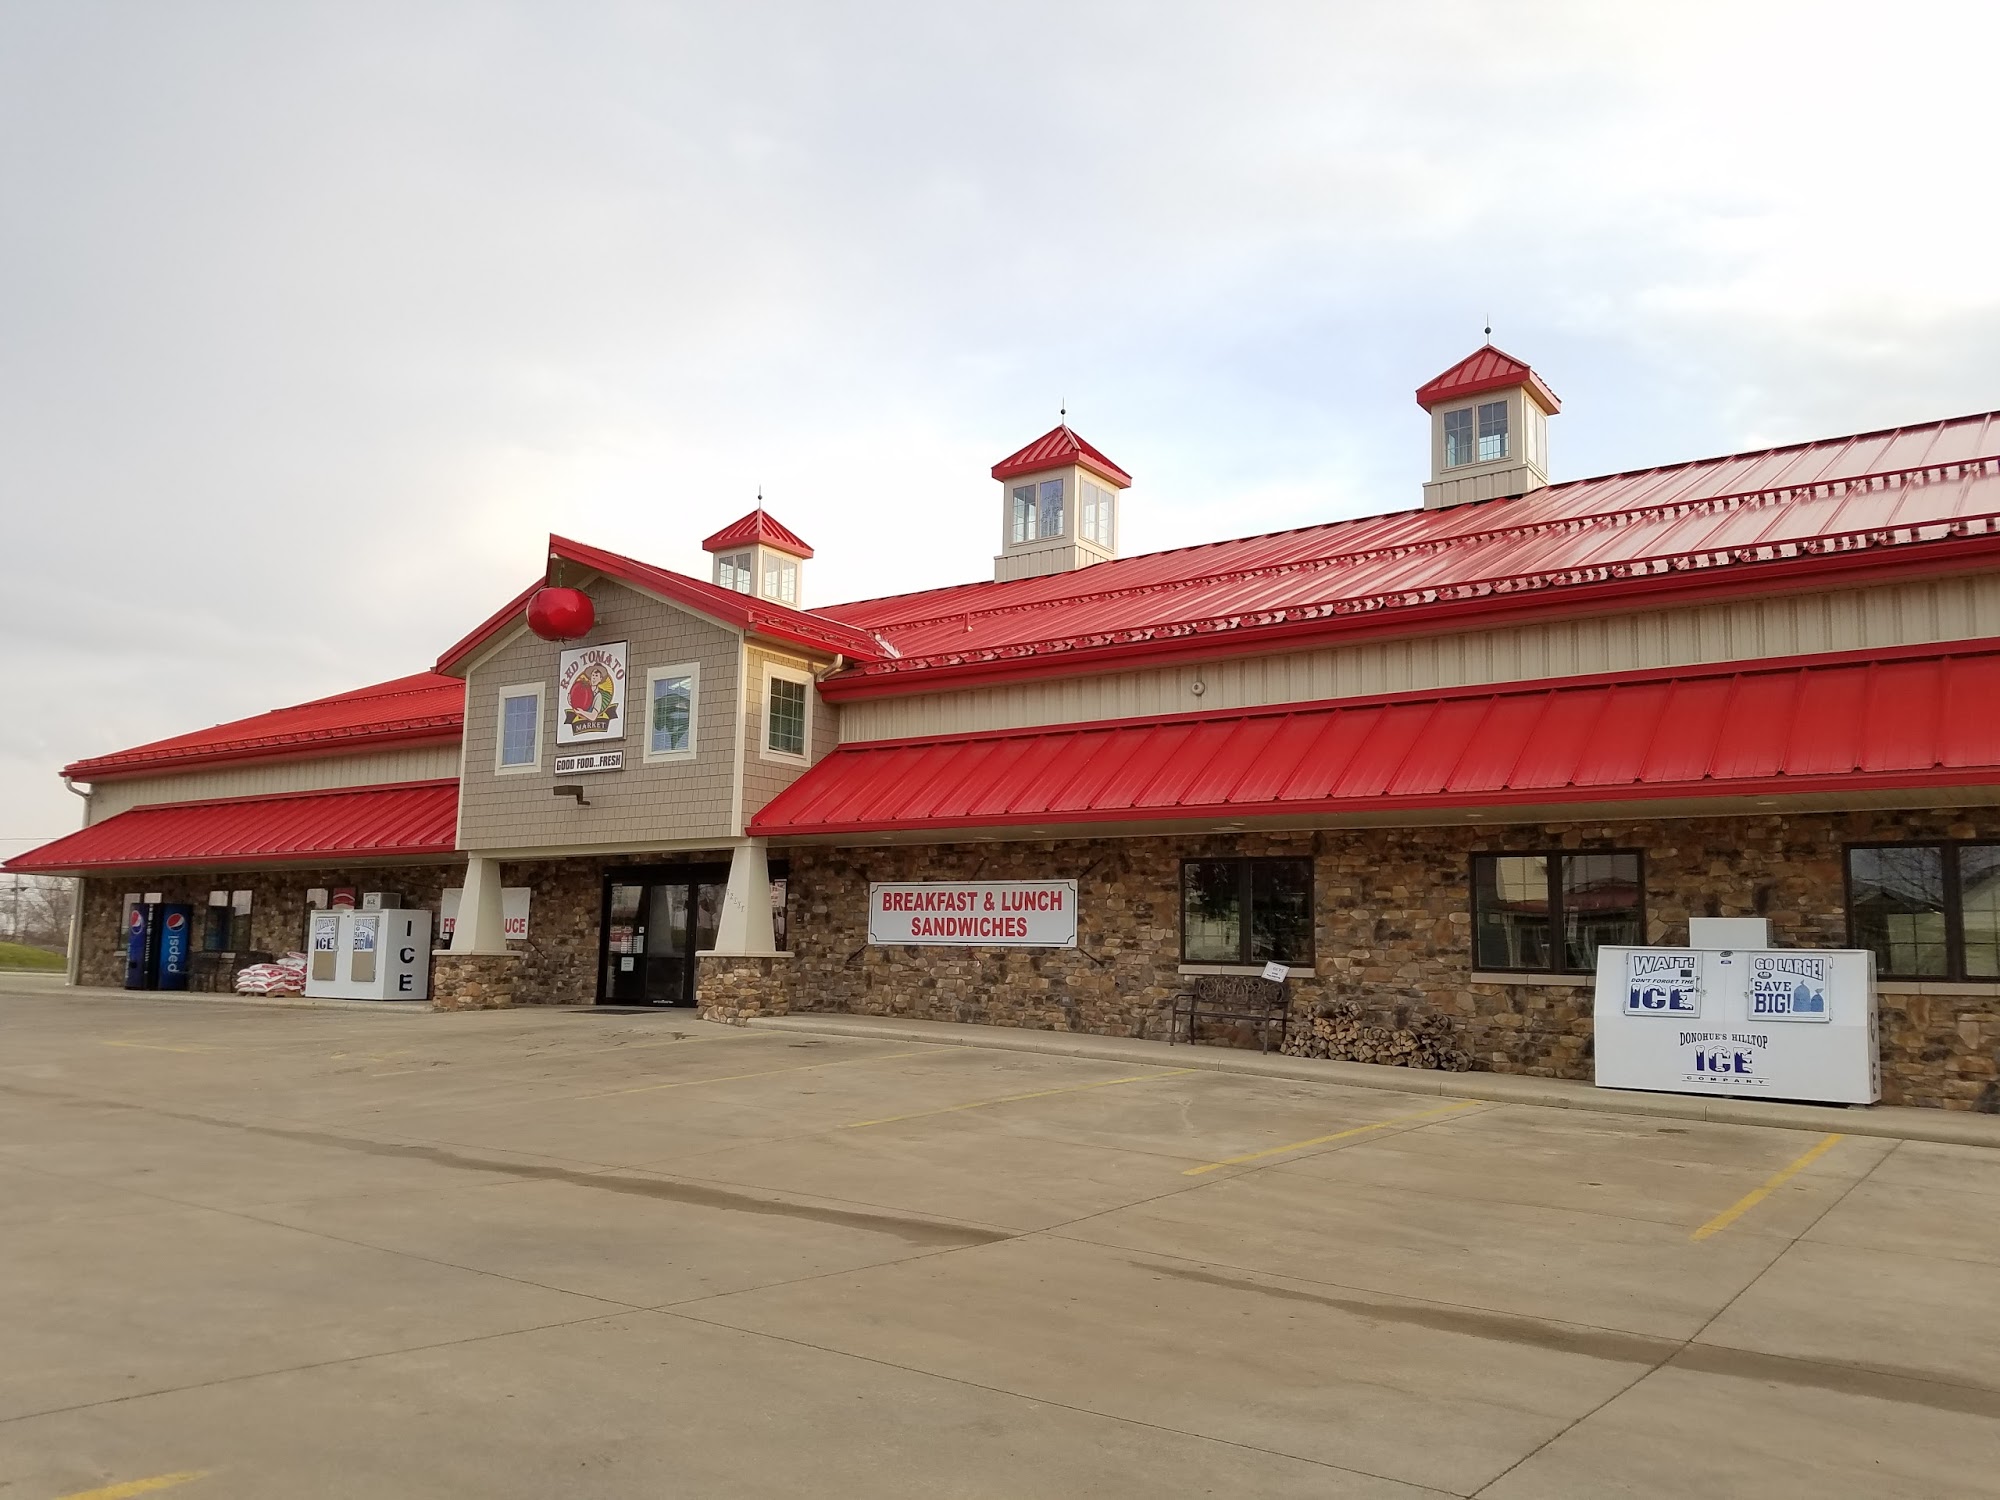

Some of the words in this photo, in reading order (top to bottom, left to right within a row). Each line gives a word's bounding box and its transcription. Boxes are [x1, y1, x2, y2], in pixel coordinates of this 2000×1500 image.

[560, 661, 579, 690] RED
[580, 650, 625, 681] TOMATO
[575, 721, 606, 732] MARKET
[556, 758, 575, 771] GOOD
[882, 891, 978, 912] BREAKFAST
[983, 892, 996, 911] &
[1001, 890, 1063, 911] LUNCH
[443, 917, 457, 933] FR
[911, 916, 1028, 937] SANDWICHES
[316, 935, 334, 950] ICE
[167, 936, 181, 972] pepsi
[399, 920, 415, 991] ICE
[1633, 955, 1695, 976] WAIT!
[1754, 957, 1775, 971] GO
[1776, 958, 1824, 981] LARGE!
[1629, 984, 1694, 1010] ICE
[1754, 981, 1792, 992] SAVE
[1754, 993, 1791, 1014] BIG!
[1679, 1032, 1728, 1046] DONOHUE'S
[1731, 1033, 1768, 1050] HILLTOP
[1694, 1044, 1754, 1074] ICE
[1686, 1075, 1765, 1084] COMPANY
